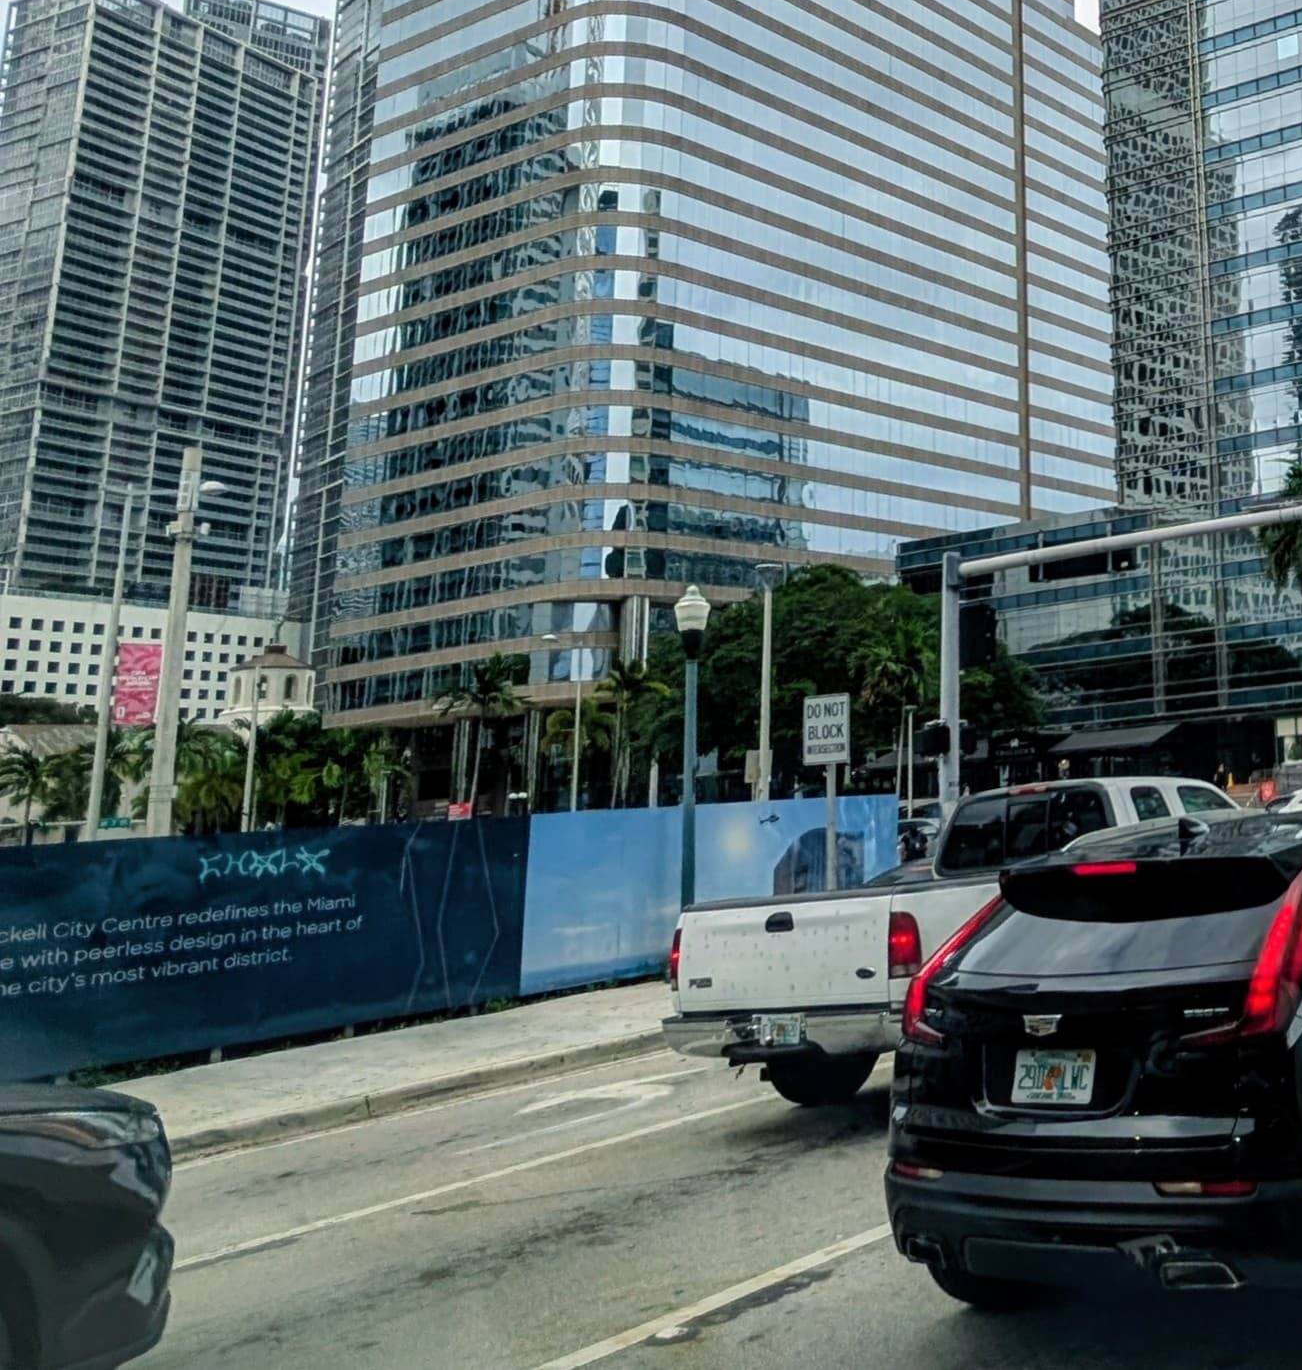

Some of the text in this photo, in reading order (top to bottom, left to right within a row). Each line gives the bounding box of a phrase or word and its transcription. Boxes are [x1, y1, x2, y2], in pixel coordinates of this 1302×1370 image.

[807, 701, 845, 719] DO NOT
[808, 723, 844, 740] BLOCK
[53, 922, 96, 938] City
[102, 916, 173, 932] Centre
[178, 905, 269, 925] redefines
[274, 900, 302, 914] the
[308, 894, 356, 911] Miami
[21, 947, 68, 968] with
[74, 941, 164, 965] peerless
[170, 935, 236, 950] design
[241, 929, 256, 942] in
[262, 925, 290, 940] the
[296, 919, 341, 935] heart
[346, 915, 363, 930] of
[28, 973, 86, 993] city's
[91, 966, 146, 985] most
[151, 957, 219, 977] vibrant
[224, 948, 293, 968] district.
